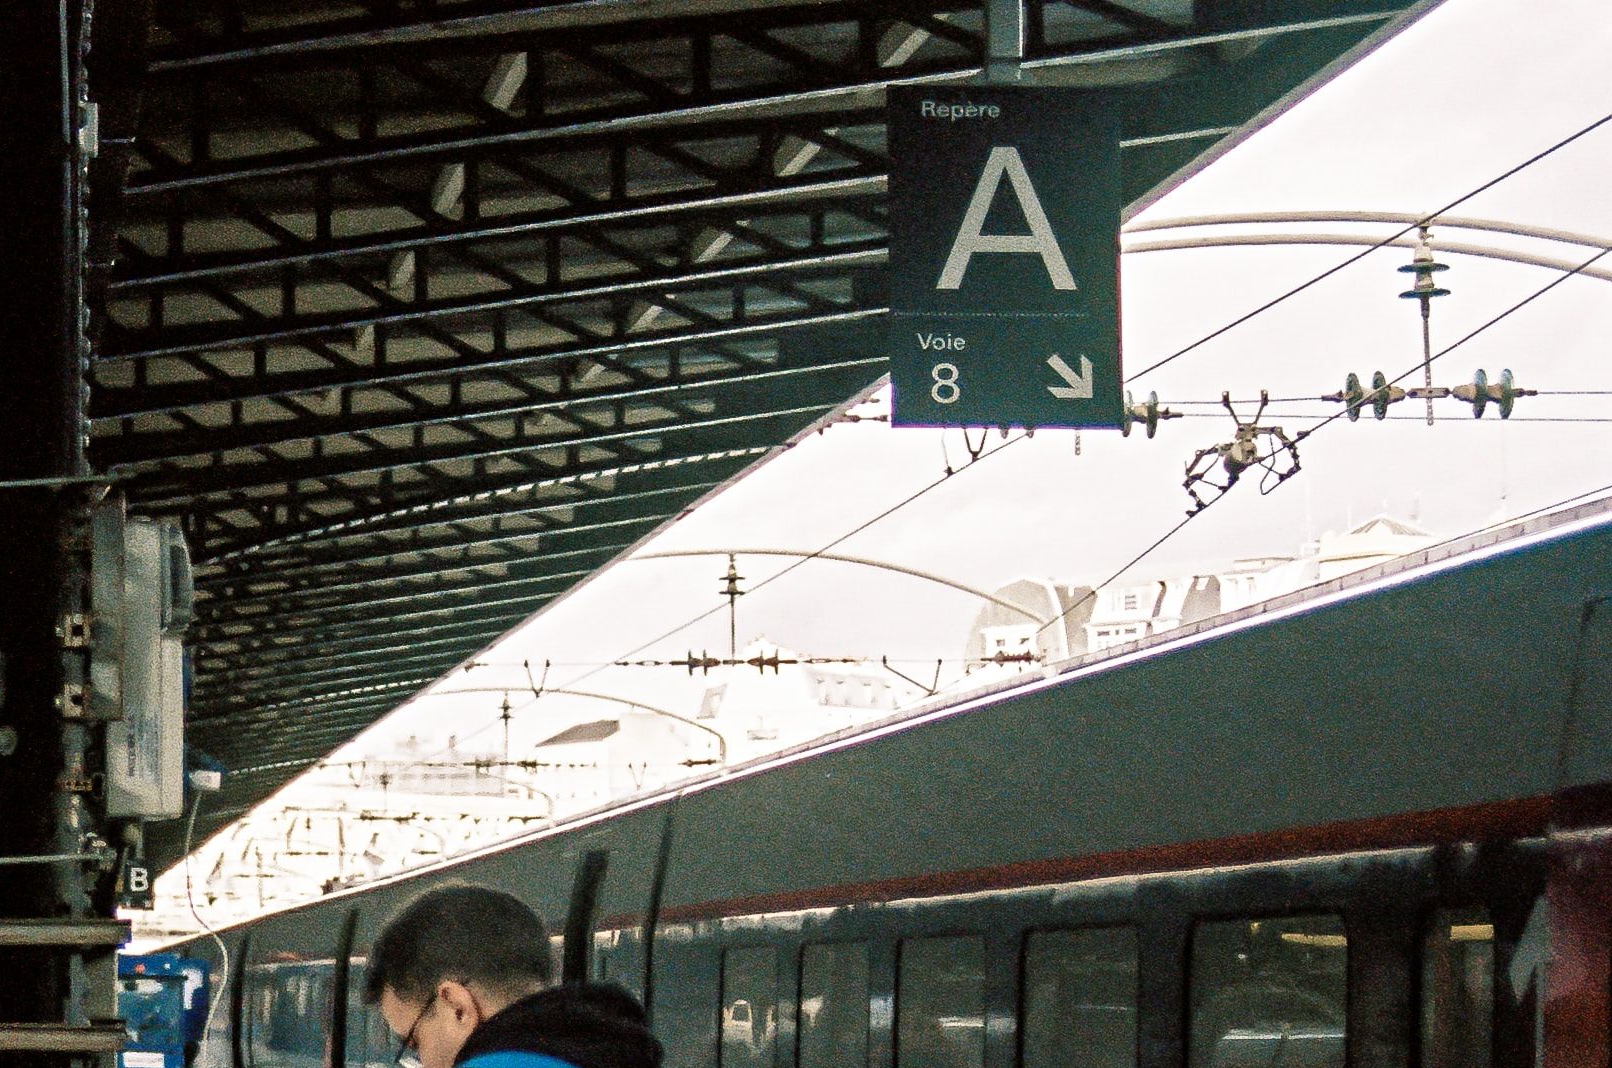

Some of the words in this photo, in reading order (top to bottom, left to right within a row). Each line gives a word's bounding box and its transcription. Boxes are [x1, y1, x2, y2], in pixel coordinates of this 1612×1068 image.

[921, 100, 1001, 122] Repère
[936, 146, 1078, 290] A
[916, 332, 966, 351] Voie
[931, 362, 961, 404] 8
[130, 867, 149, 892] B
